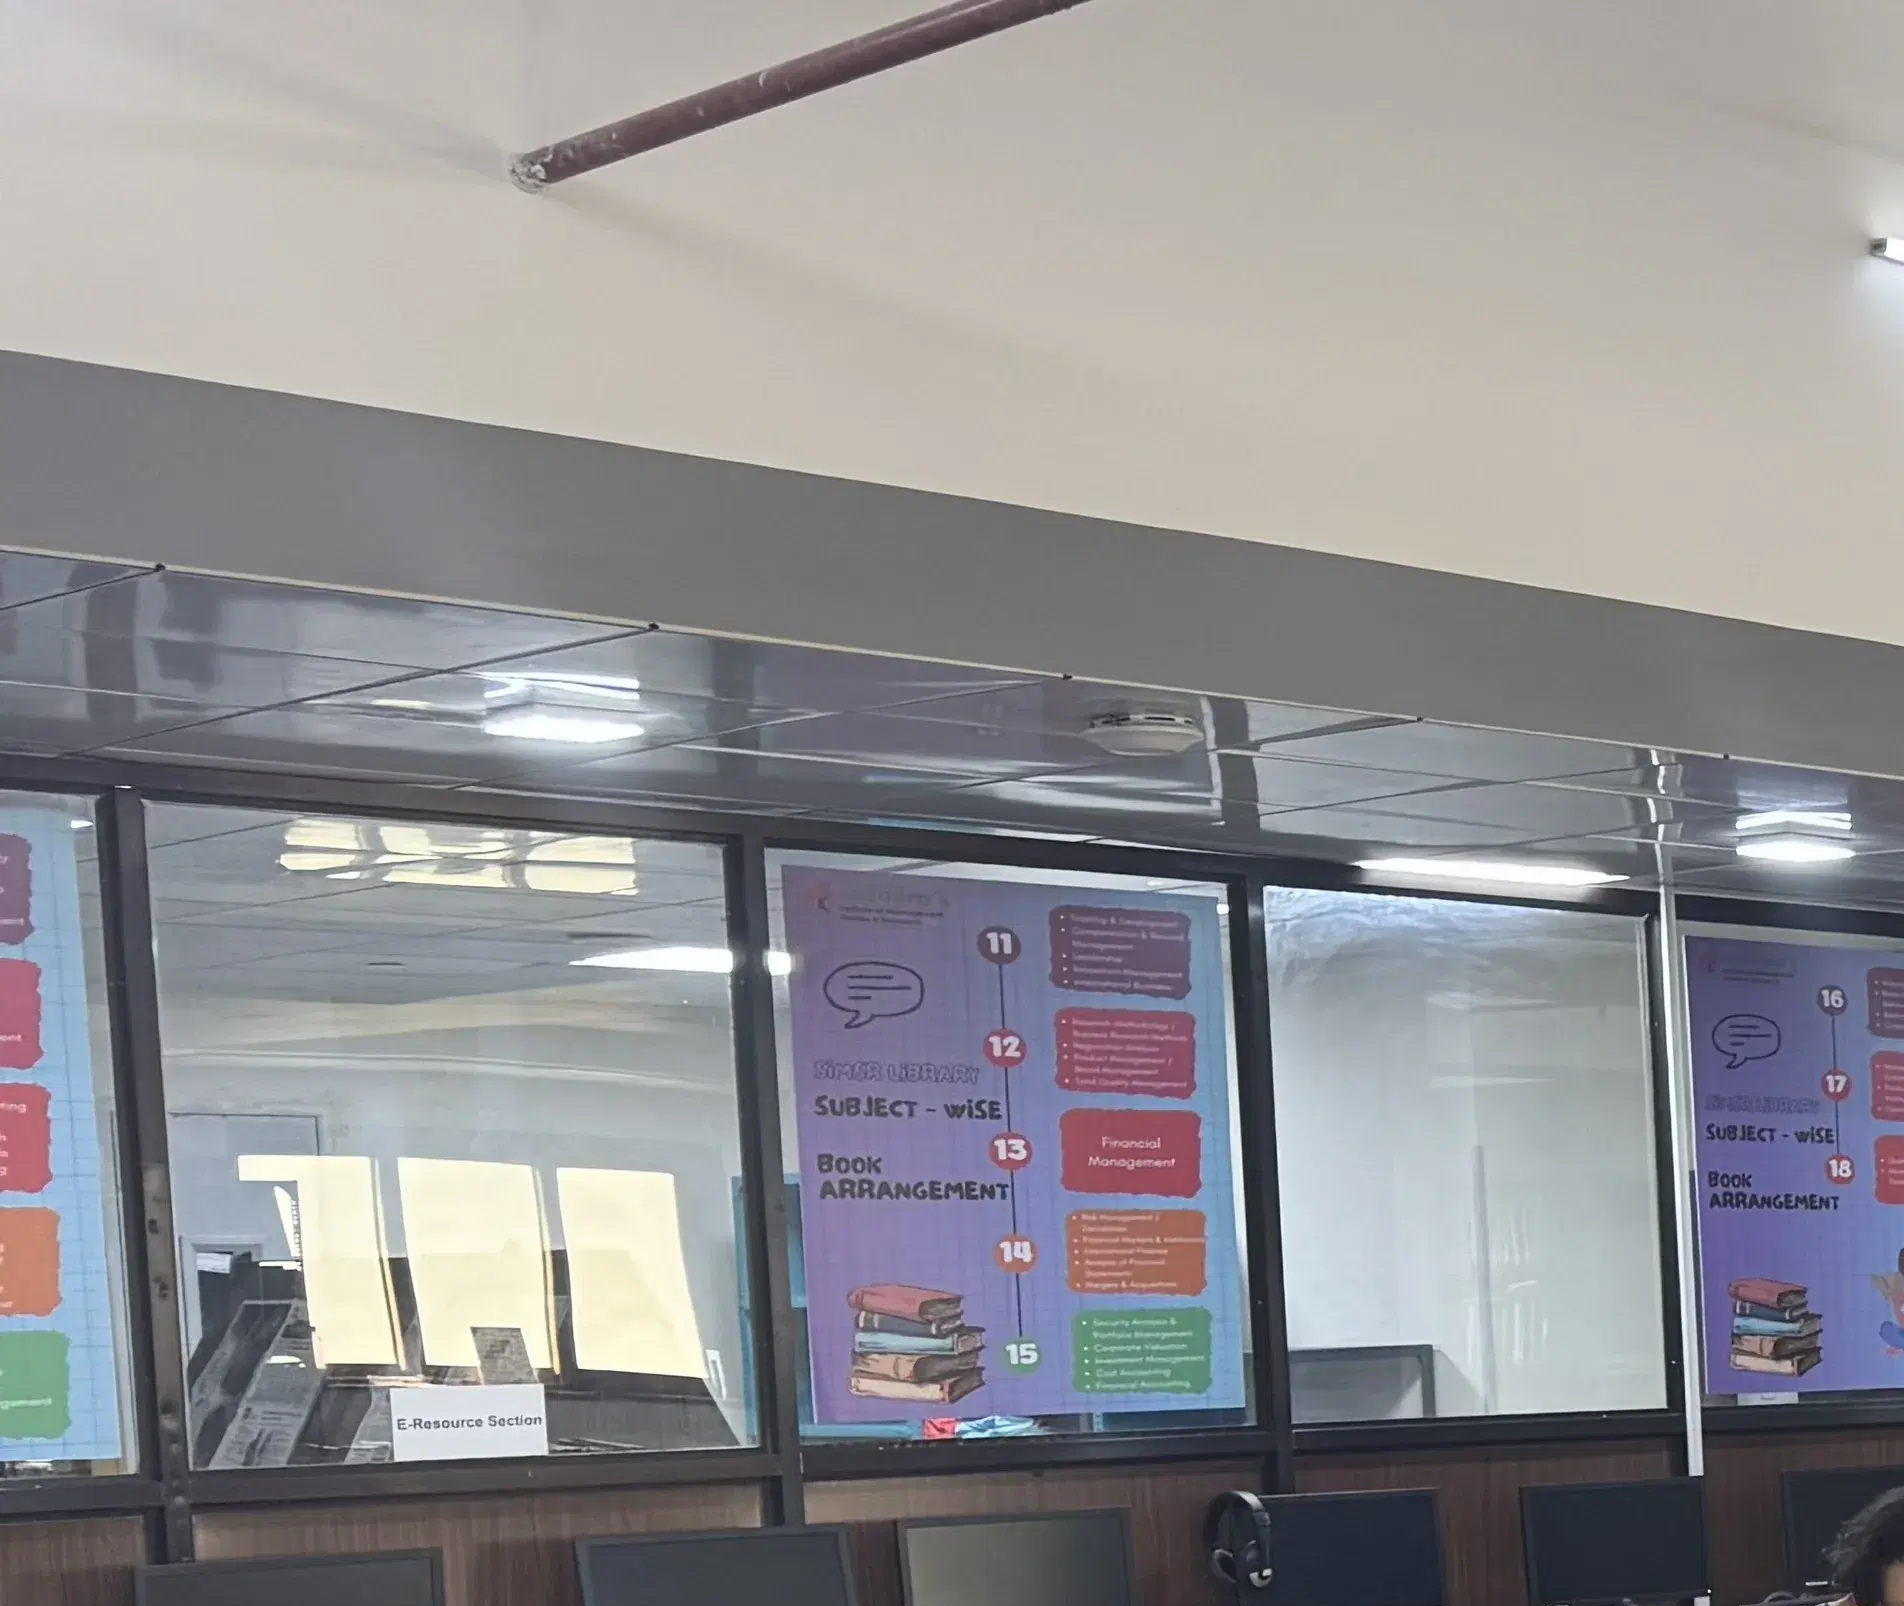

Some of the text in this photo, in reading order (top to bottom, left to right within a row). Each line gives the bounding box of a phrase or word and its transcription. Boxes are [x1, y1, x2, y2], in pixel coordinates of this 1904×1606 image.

[986, 932, 1012, 955] 11
[1820, 989, 1844, 1008] 16
[988, 1035, 1021, 1058] 12
[1826, 1074, 1847, 1093] 17
[814, 1095, 918, 1118] SUBJECT
[1102, 1136, 1161, 1149] Financial
[1706, 1123, 1776, 1143] SUBJECT
[993, 1139, 1028, 1161] 13
[1088, 1156, 1176, 1170] Management
[1829, 1159, 1852, 1178] 18
[819, 1178, 1009, 1201] ARRANGEMENT
[1709, 1191, 1840, 1210] ARRANGEMENT
[1000, 1240, 1033, 1264] 14
[1006, 1341, 1037, 1364] 15
[396, 1414, 542, 1431] E-Resource Section
